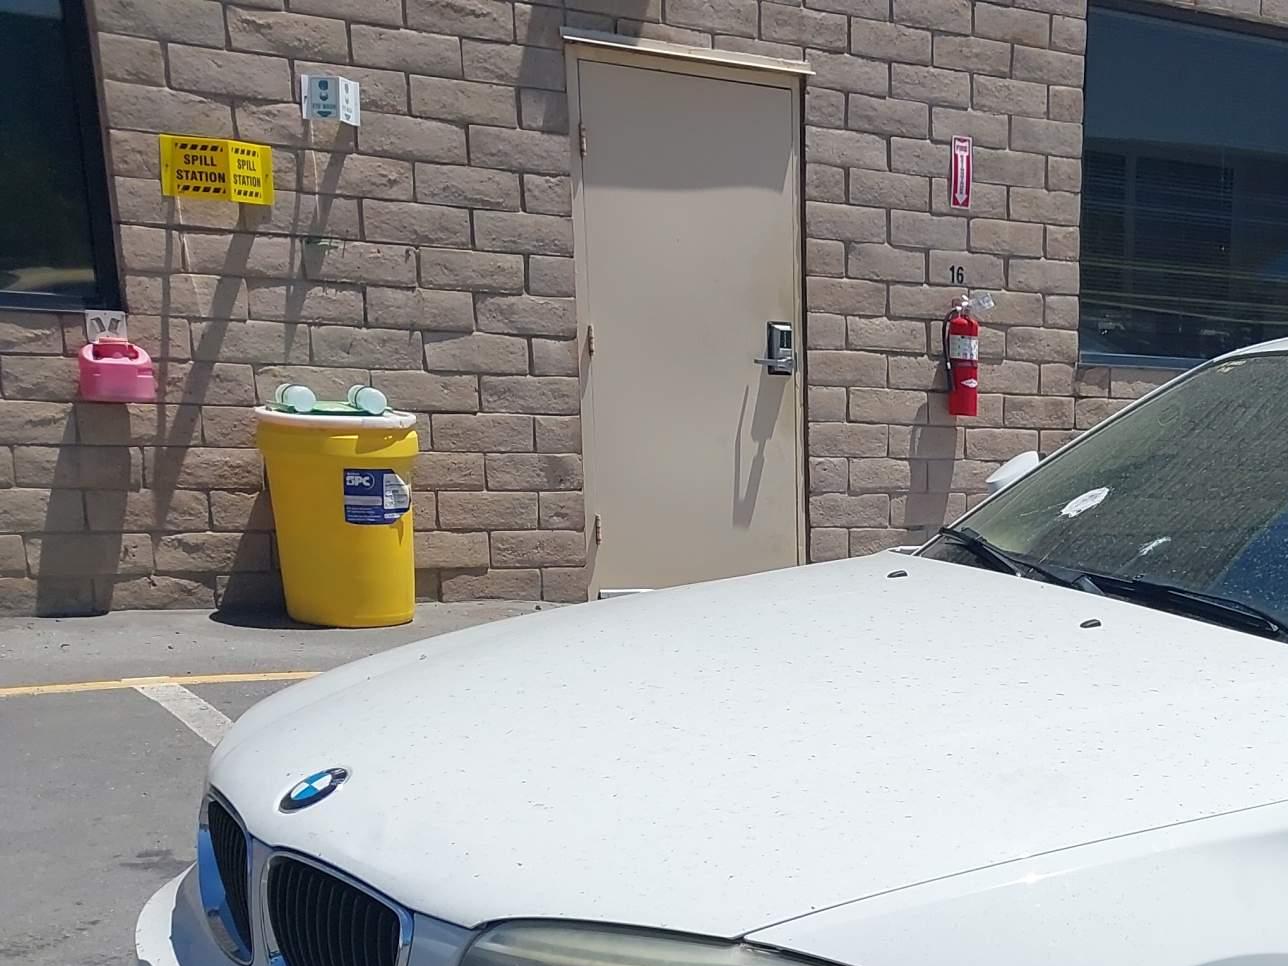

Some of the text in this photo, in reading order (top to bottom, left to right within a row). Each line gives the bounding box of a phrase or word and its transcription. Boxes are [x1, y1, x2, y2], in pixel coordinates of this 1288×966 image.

[183, 154, 217, 167] SPILL
[237, 159, 257, 171] SPILL
[176, 169, 226, 183] STATION
[233, 174, 262, 187] STATION
[949, 265, 965, 285] 16
